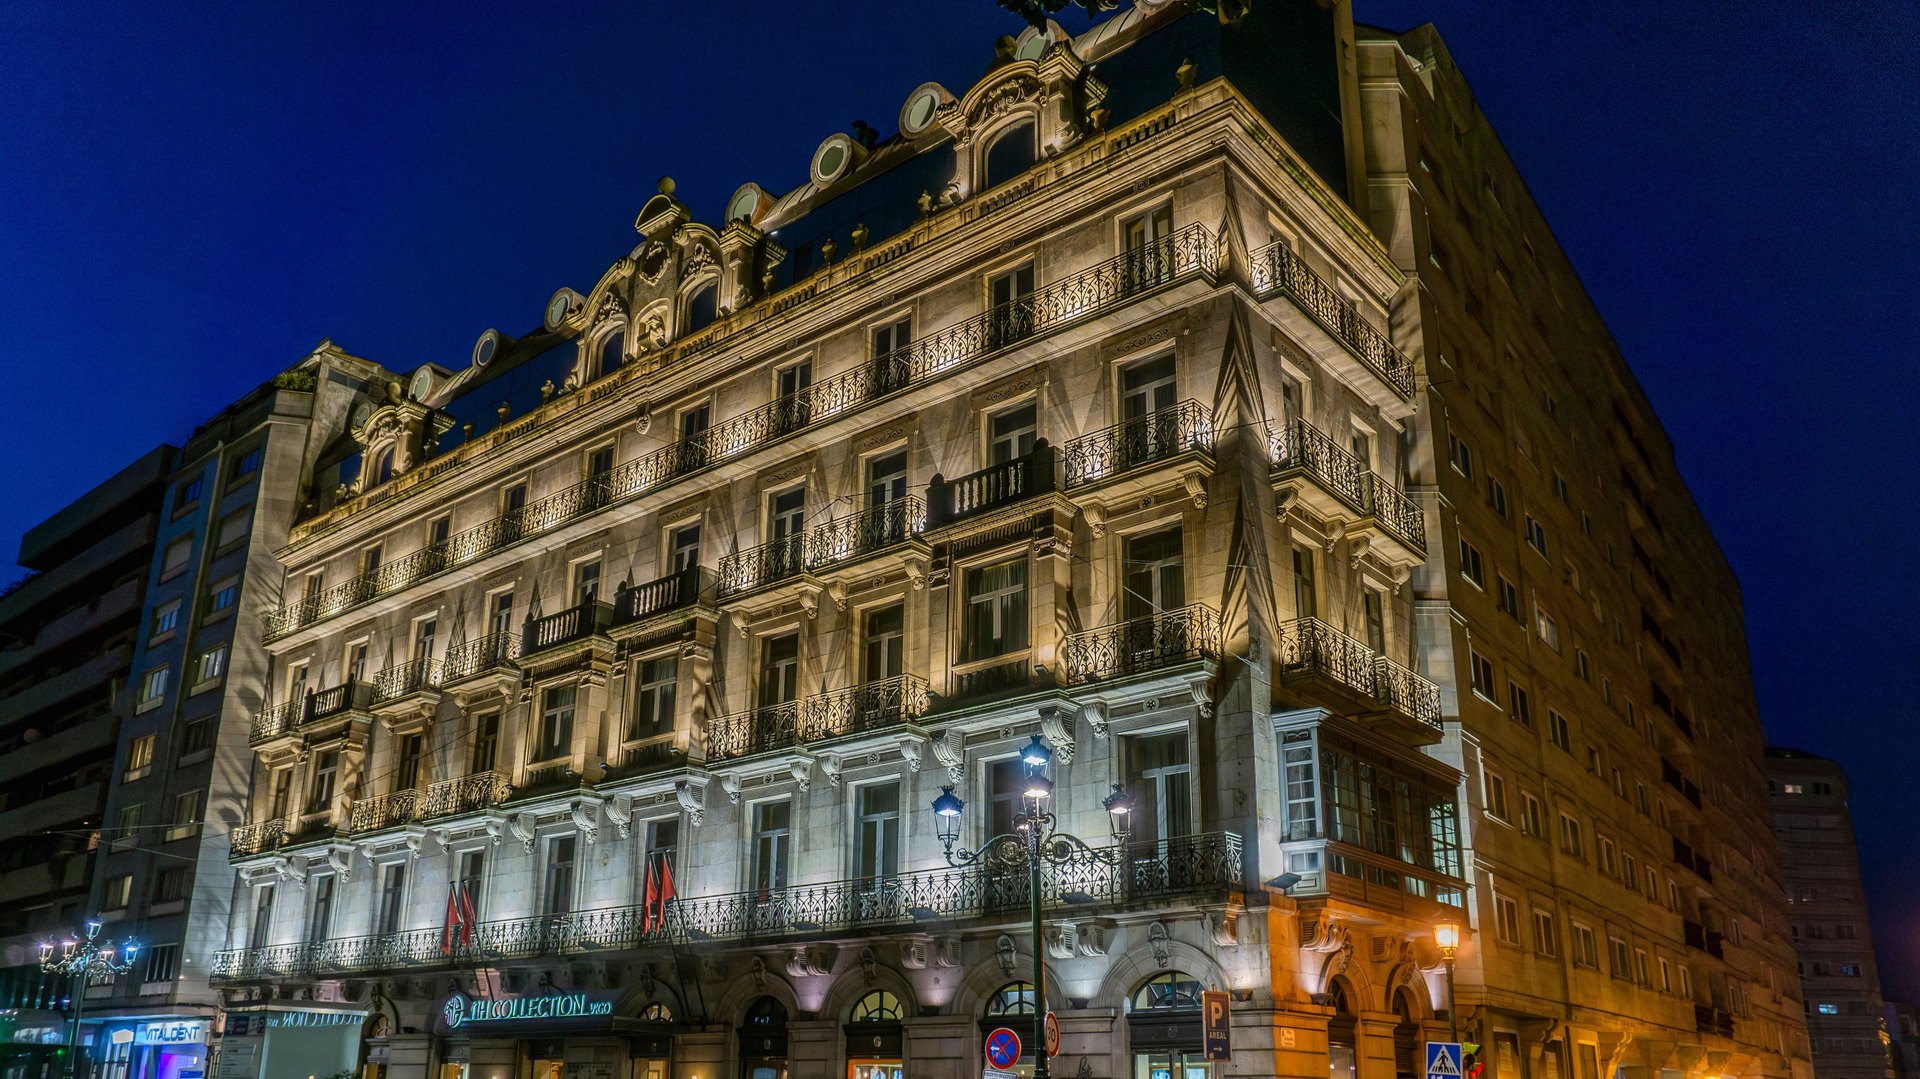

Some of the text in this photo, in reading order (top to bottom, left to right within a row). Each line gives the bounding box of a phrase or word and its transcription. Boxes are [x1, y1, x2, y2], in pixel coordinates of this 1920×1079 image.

[492, 994, 586, 1018] COLLECTION
[590, 1001, 613, 1015] VIGO
[1210, 1001, 1223, 1028] P
[146, 1026, 200, 1041] VITALDENT
[1047, 1026, 1056, 1042] 30
[1208, 1031, 1227, 1040] AREAL
